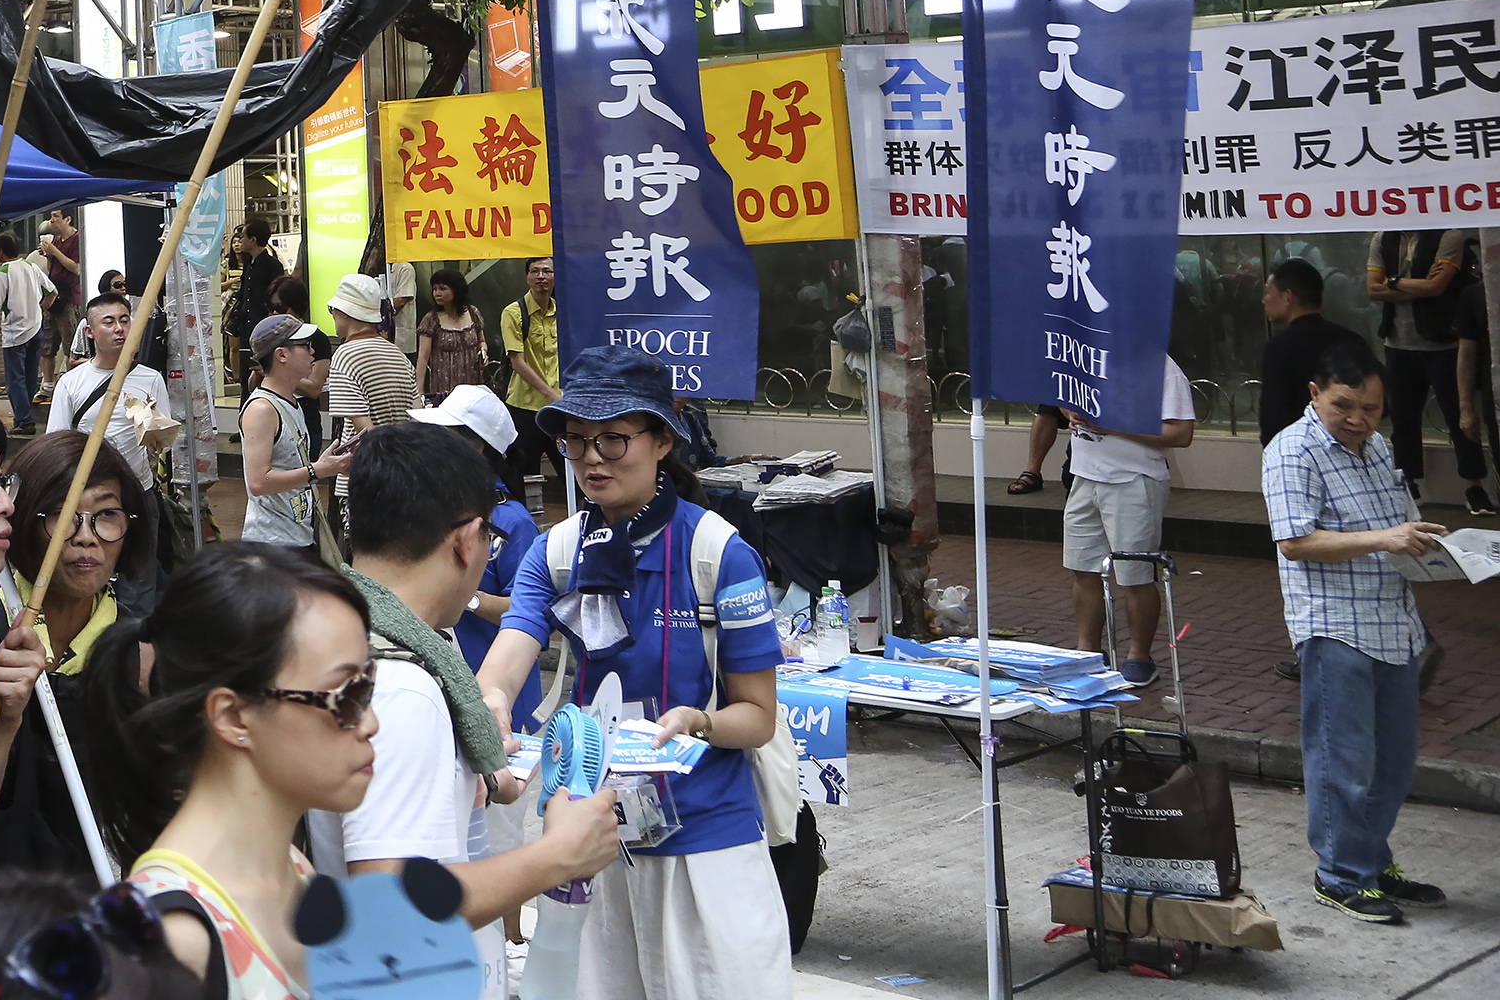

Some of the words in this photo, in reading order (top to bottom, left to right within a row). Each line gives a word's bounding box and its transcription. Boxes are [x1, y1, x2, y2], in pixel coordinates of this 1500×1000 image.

[1224, 19, 1500, 113] 江泽民
[315, 213, 338, 225] 2864
[339, 212, 363, 224] 4229
[404, 202, 512, 242] FALUN
[736, 180, 831, 223] OOD
[889, 192, 967, 218] BRIN
[1259, 193, 1312, 220] TO
[1044, 330, 1110, 380] EPOCH
[1051, 369, 1102, 420] TIMES
[1155, 808, 1184, 817] FOODS
